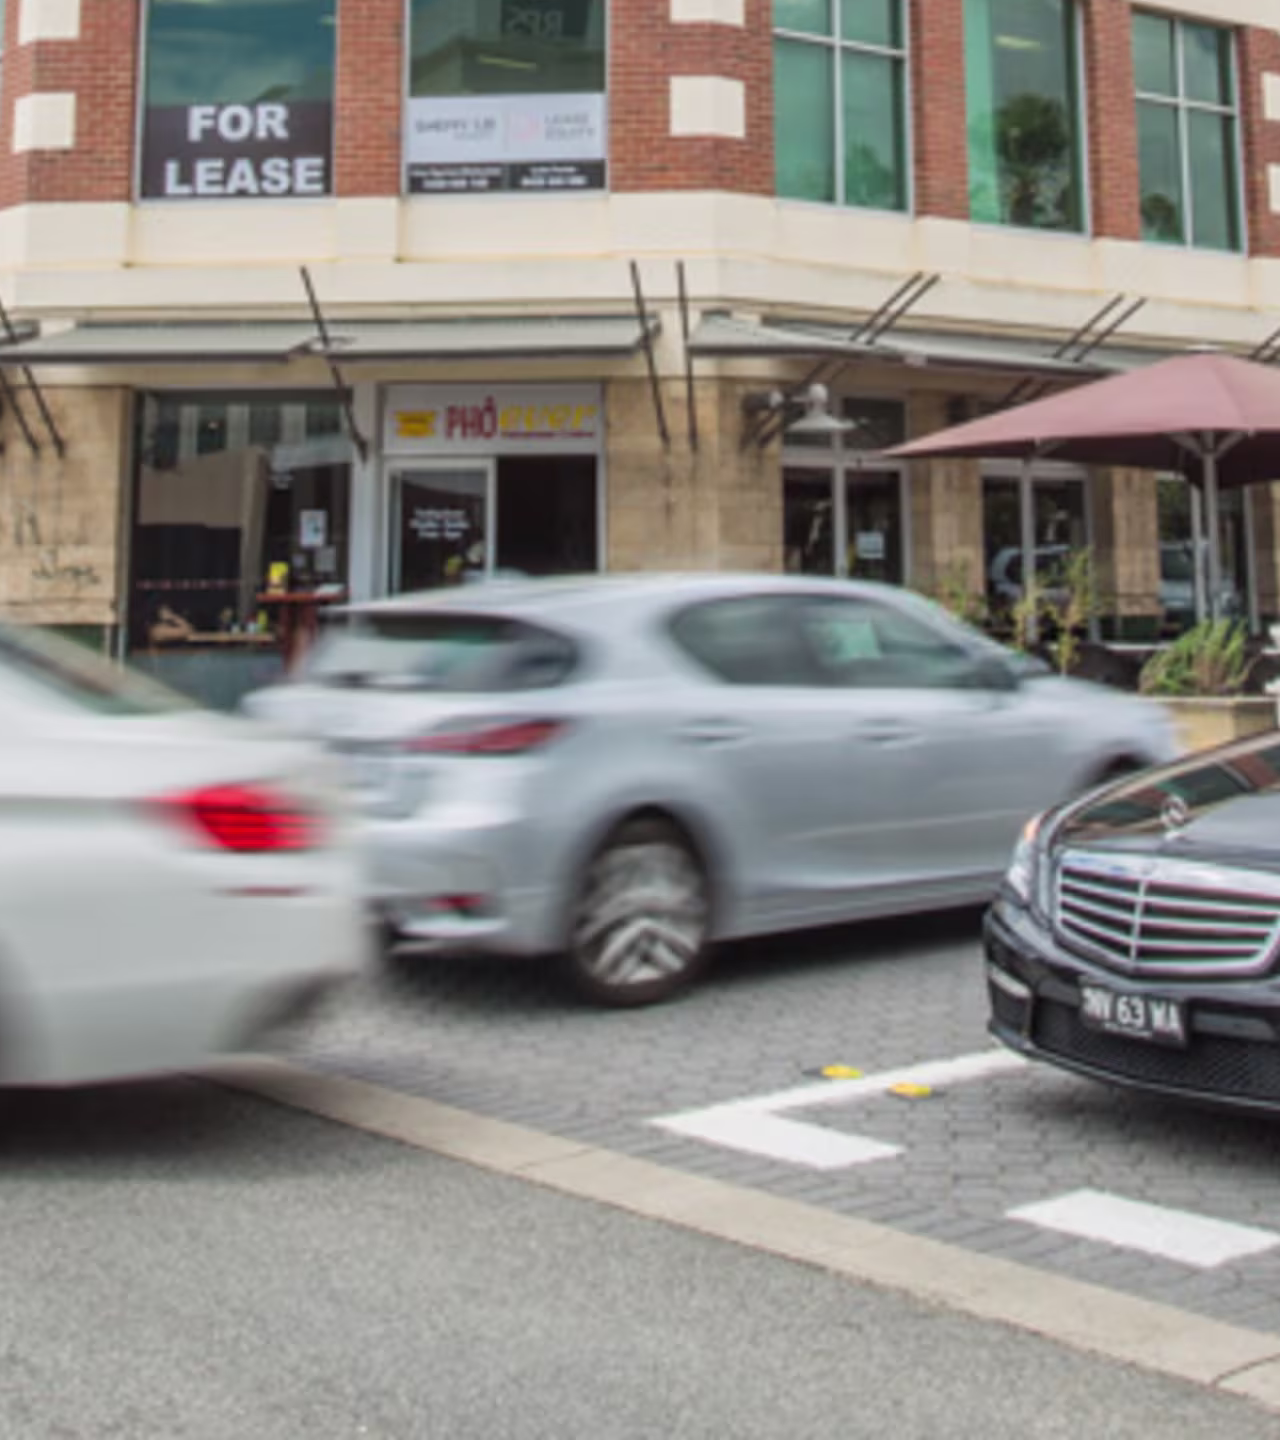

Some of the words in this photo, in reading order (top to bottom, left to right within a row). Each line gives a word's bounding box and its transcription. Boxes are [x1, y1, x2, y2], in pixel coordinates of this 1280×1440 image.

[187, 103, 289, 142] FOR
[164, 157, 325, 195] LEASE
[500, 404, 598, 430] ever
[1117, 994, 1145, 1028] 63
